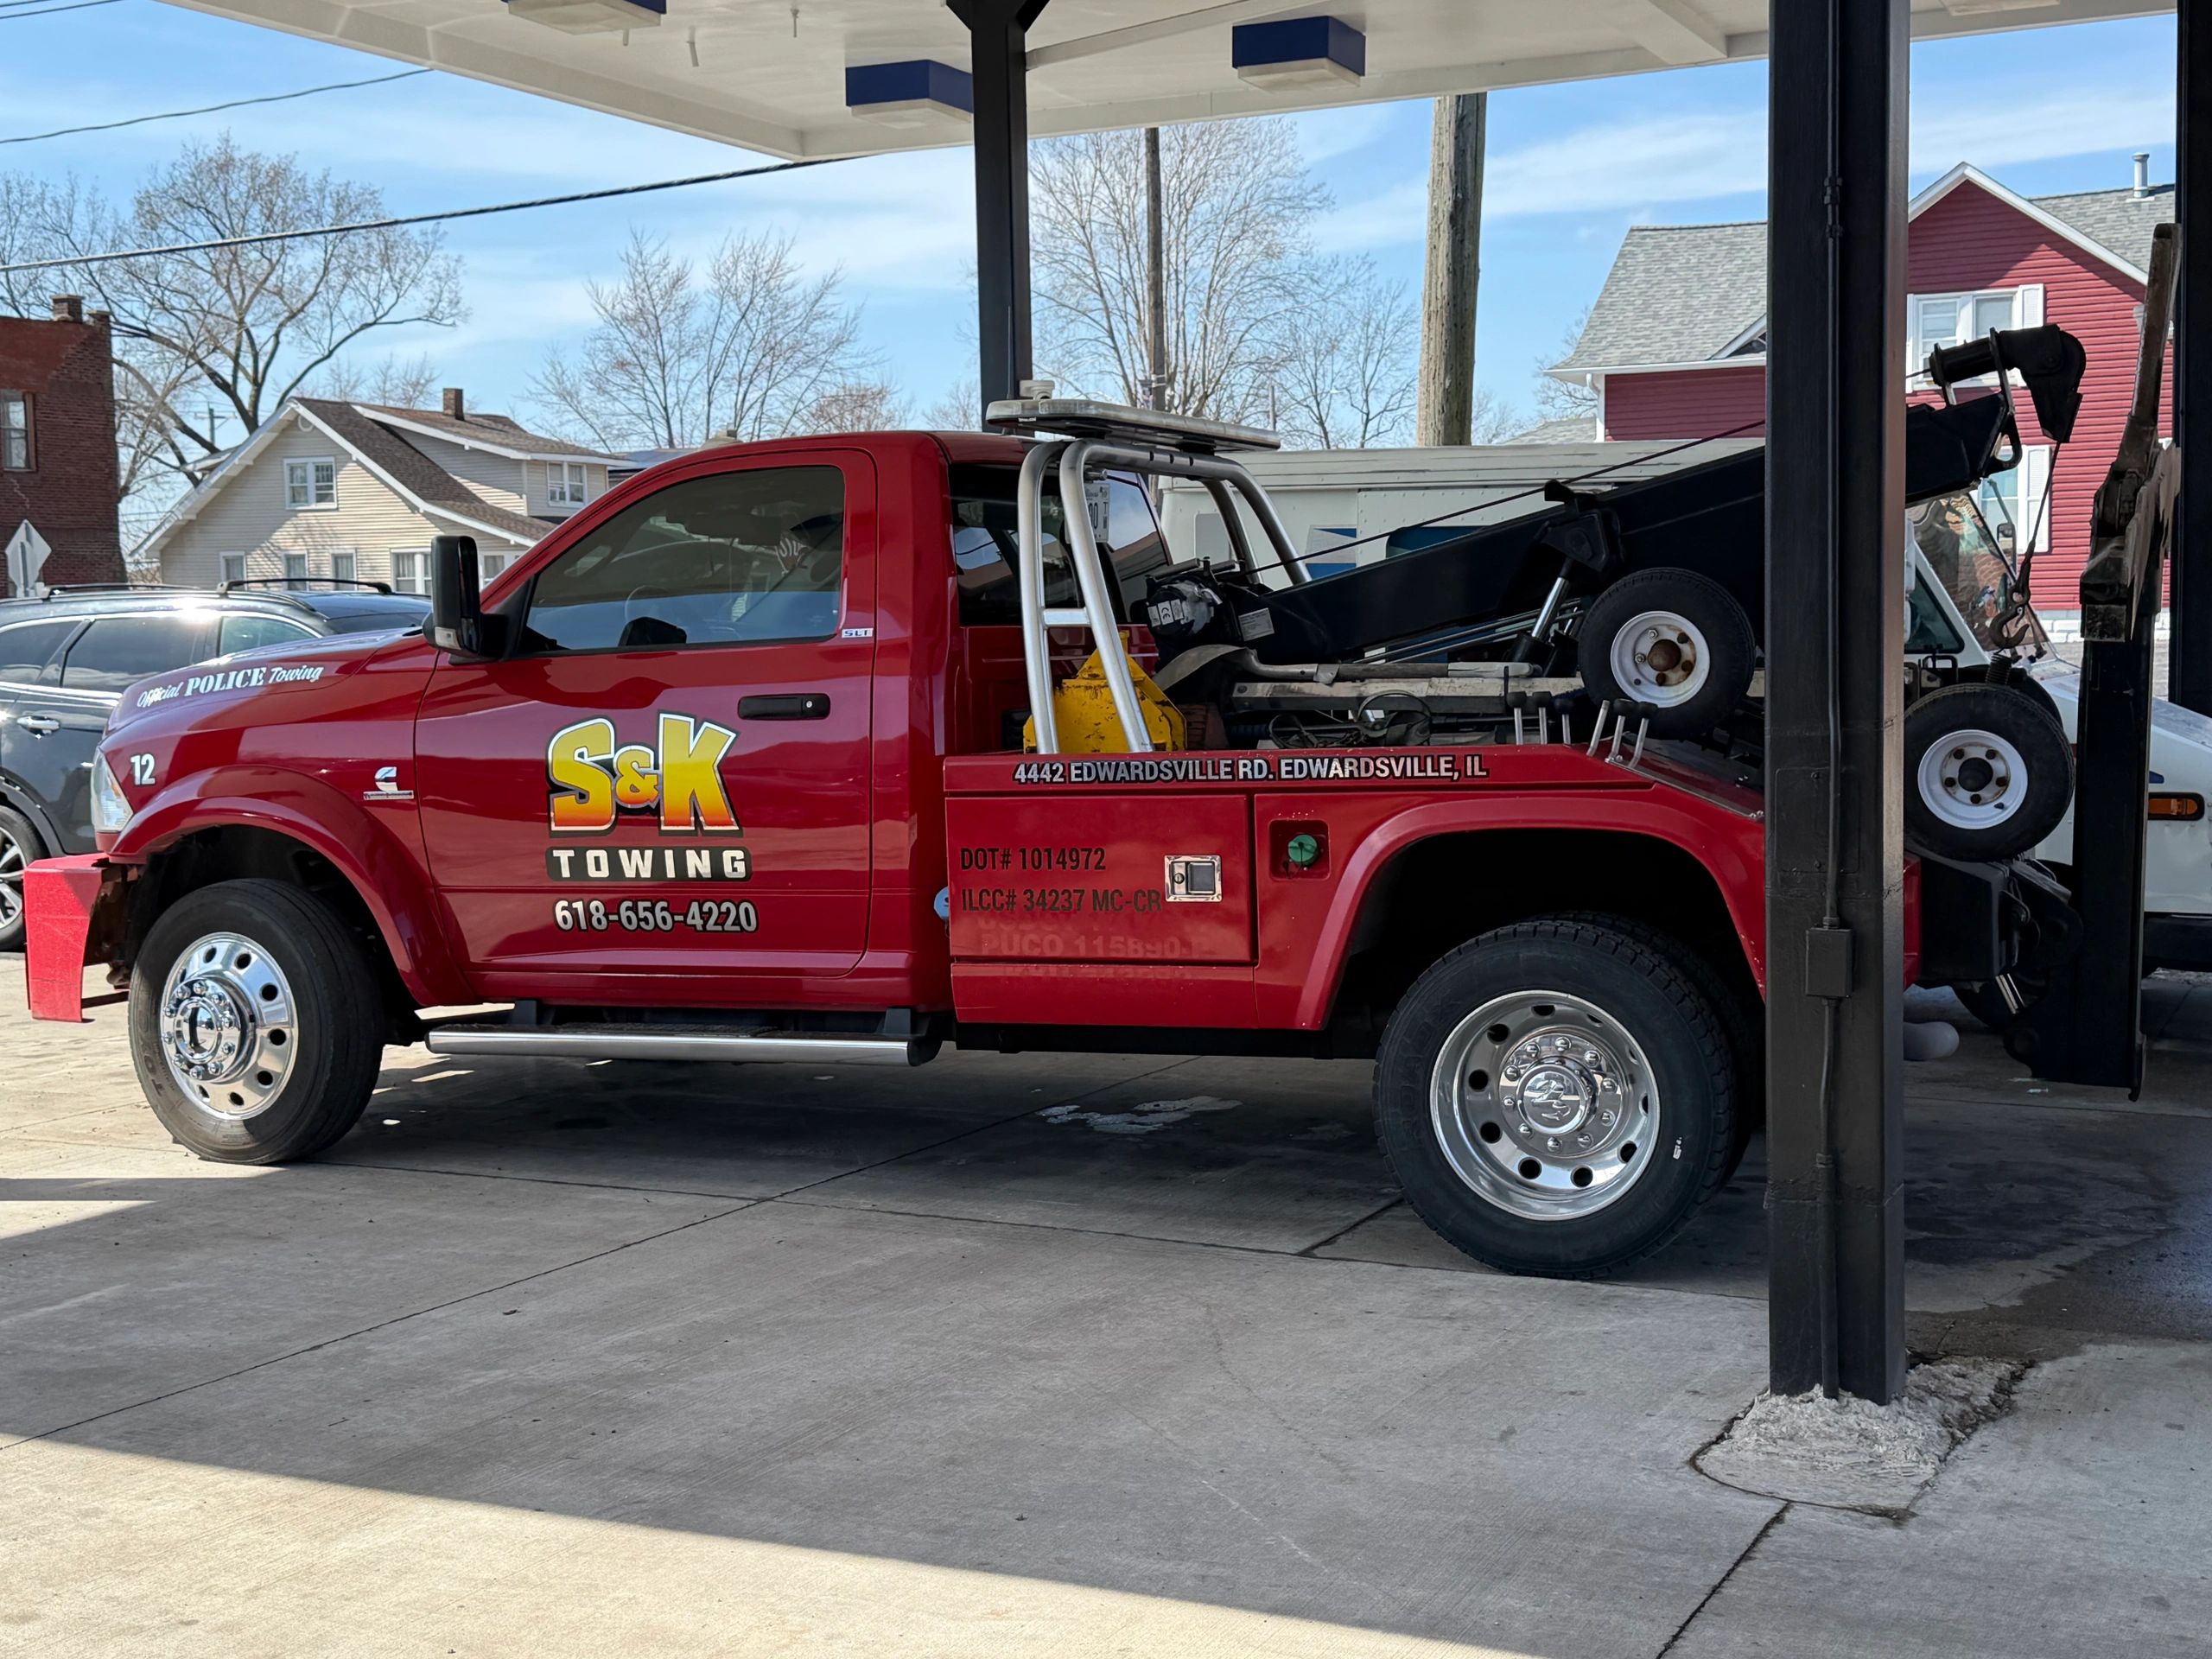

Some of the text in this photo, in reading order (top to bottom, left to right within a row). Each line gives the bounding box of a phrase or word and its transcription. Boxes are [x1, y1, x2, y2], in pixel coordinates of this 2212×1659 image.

[137, 664, 325, 708] Official POLICE Towing
[130, 753, 156, 786] 12
[547, 710, 742, 837] S&K
[1014, 754, 1487, 783] 4442 EDWARDSVILLE RD. EDWARDSVILLE, IL
[552, 849, 747, 879] TOWING
[961, 847, 1107, 871] DOT# 1014972
[554, 899, 759, 933] 618-656-4220
[961, 888, 1163, 913] ILCC# 34237 MC-CR
